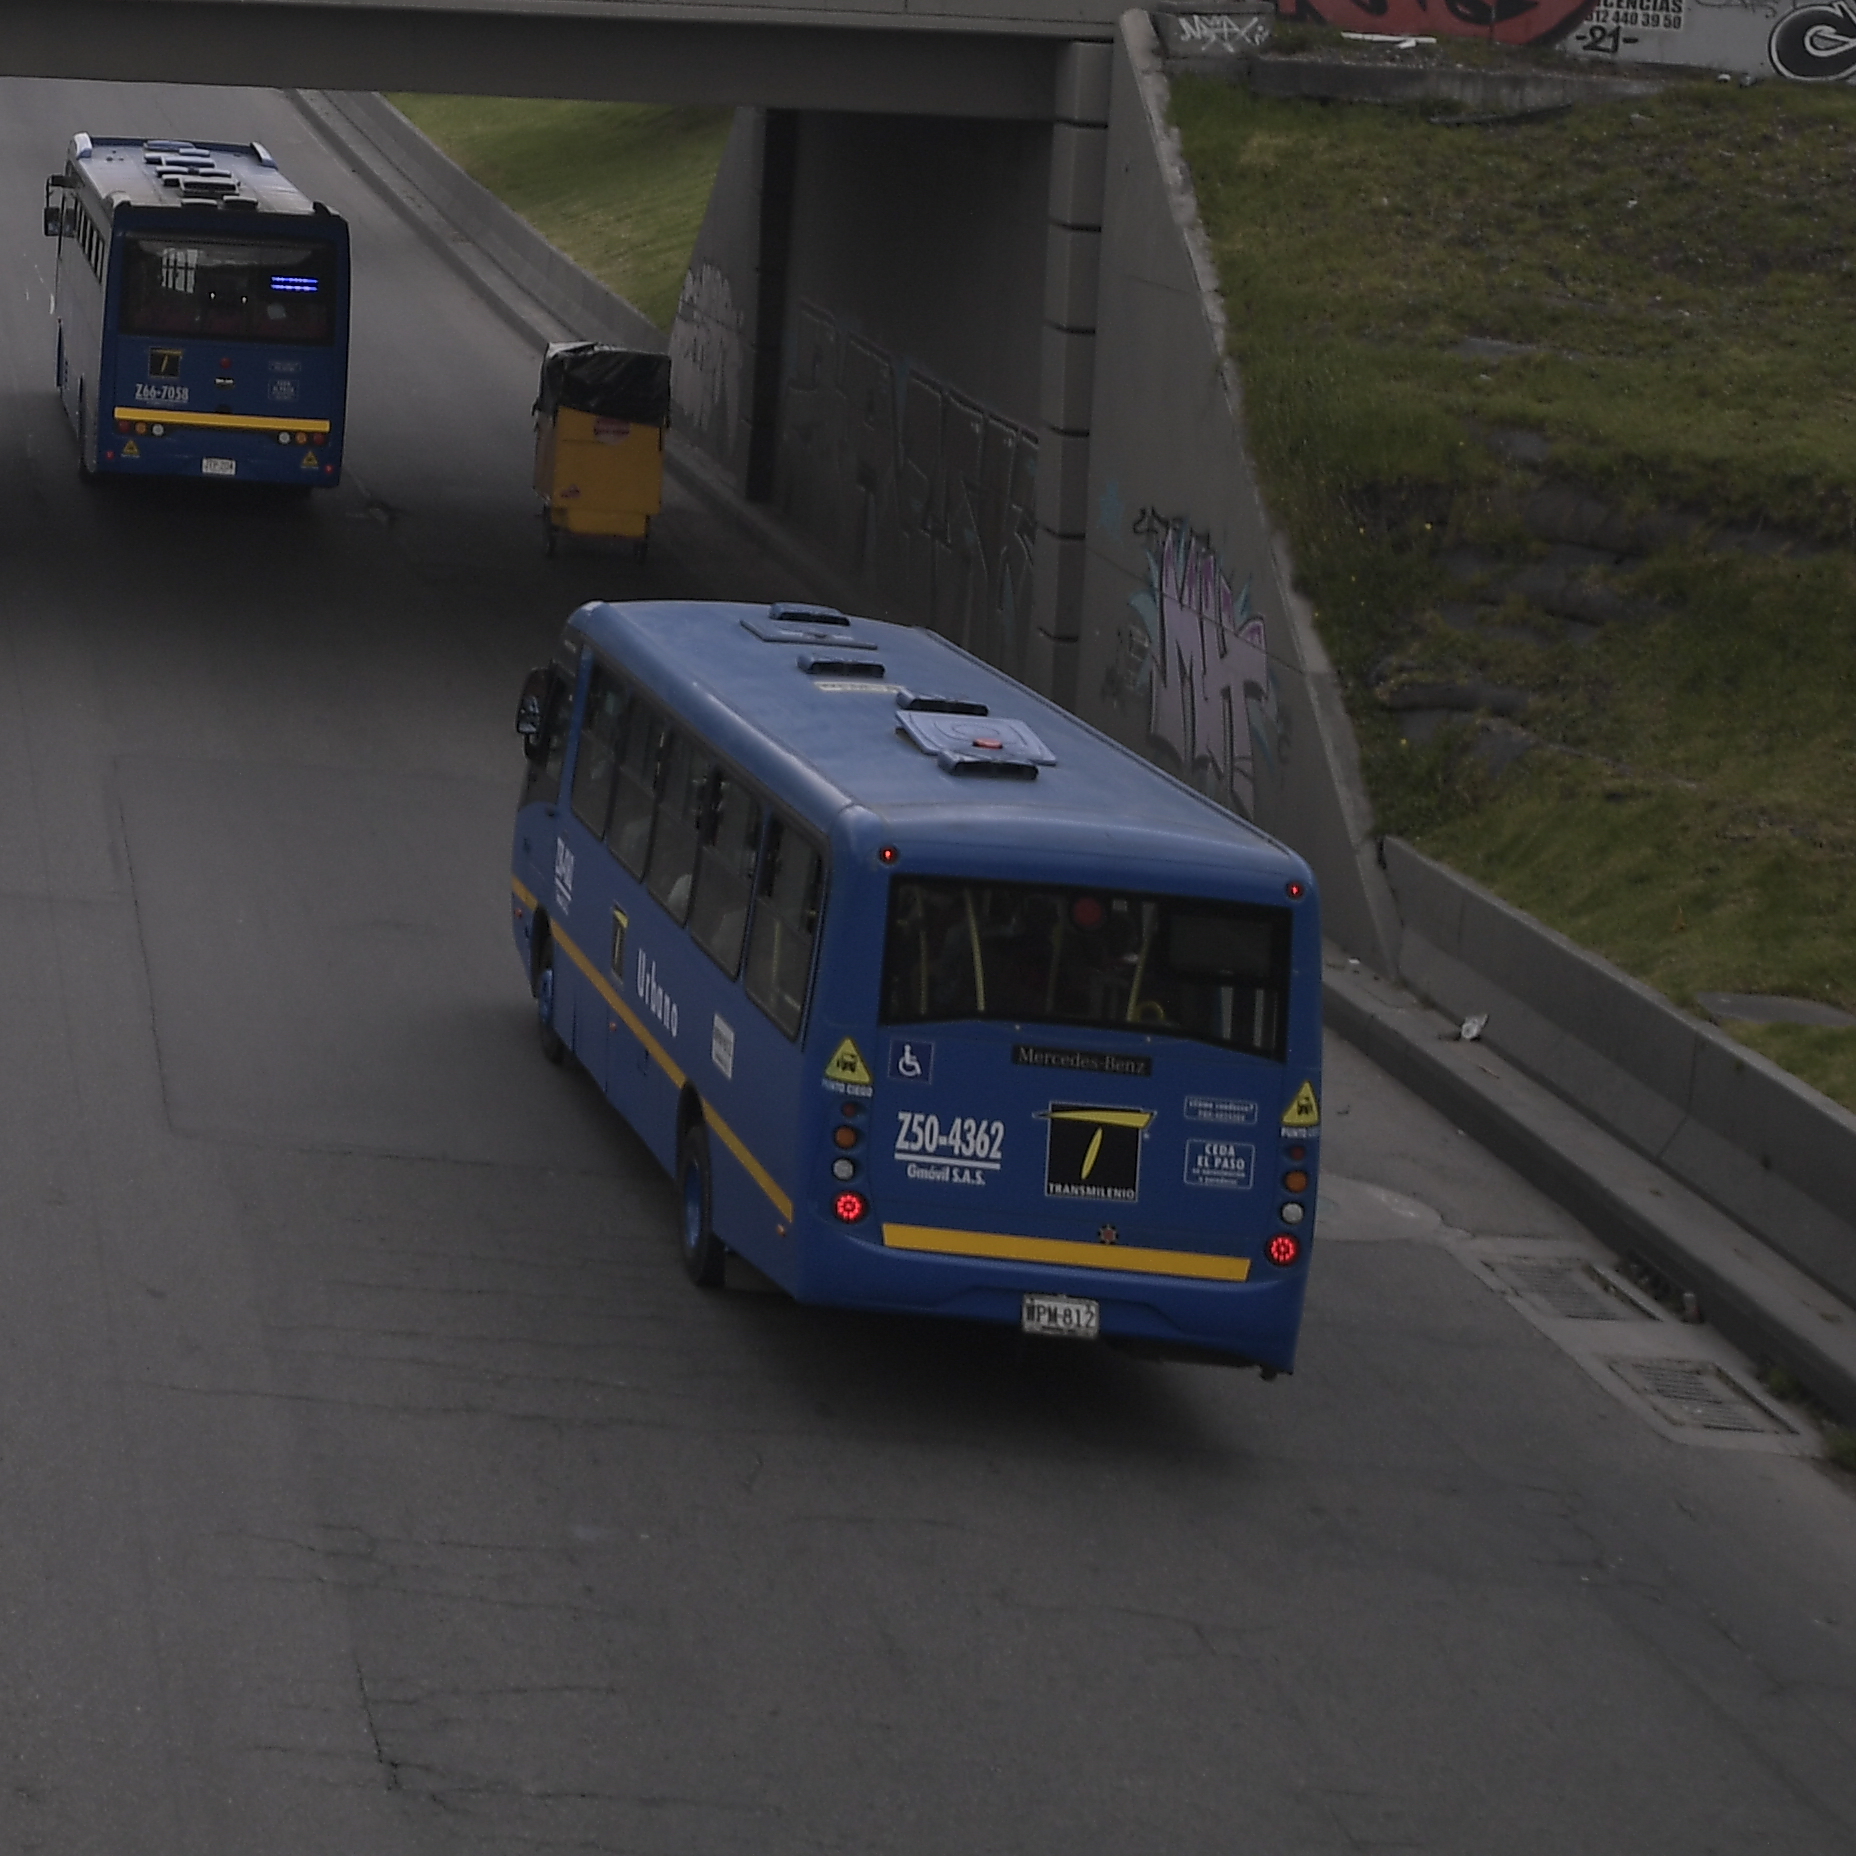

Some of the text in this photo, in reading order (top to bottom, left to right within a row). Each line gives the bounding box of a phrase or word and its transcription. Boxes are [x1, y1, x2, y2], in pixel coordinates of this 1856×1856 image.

[1612, 11, 1638, 25] 440
[1641, 13, 1660, 27] 39
[1663, 15, 1682, 29] 50
[636, 947, 679, 1038] Urbano
[1018, 1046, 1146, 1075] Mercedes-Benz
[846, 1082, 873, 1097] CIEGO
[894, 1111, 1004, 1159] Z50-4362
[1204, 1143, 1235, 1156] CEDA
[1197, 1155, 1245, 1170] EL PASO
[907, 1162, 986, 1186] Gmóvil S.A.S.
[1048, 1183, 1135, 1200] TRANSMILENIO
